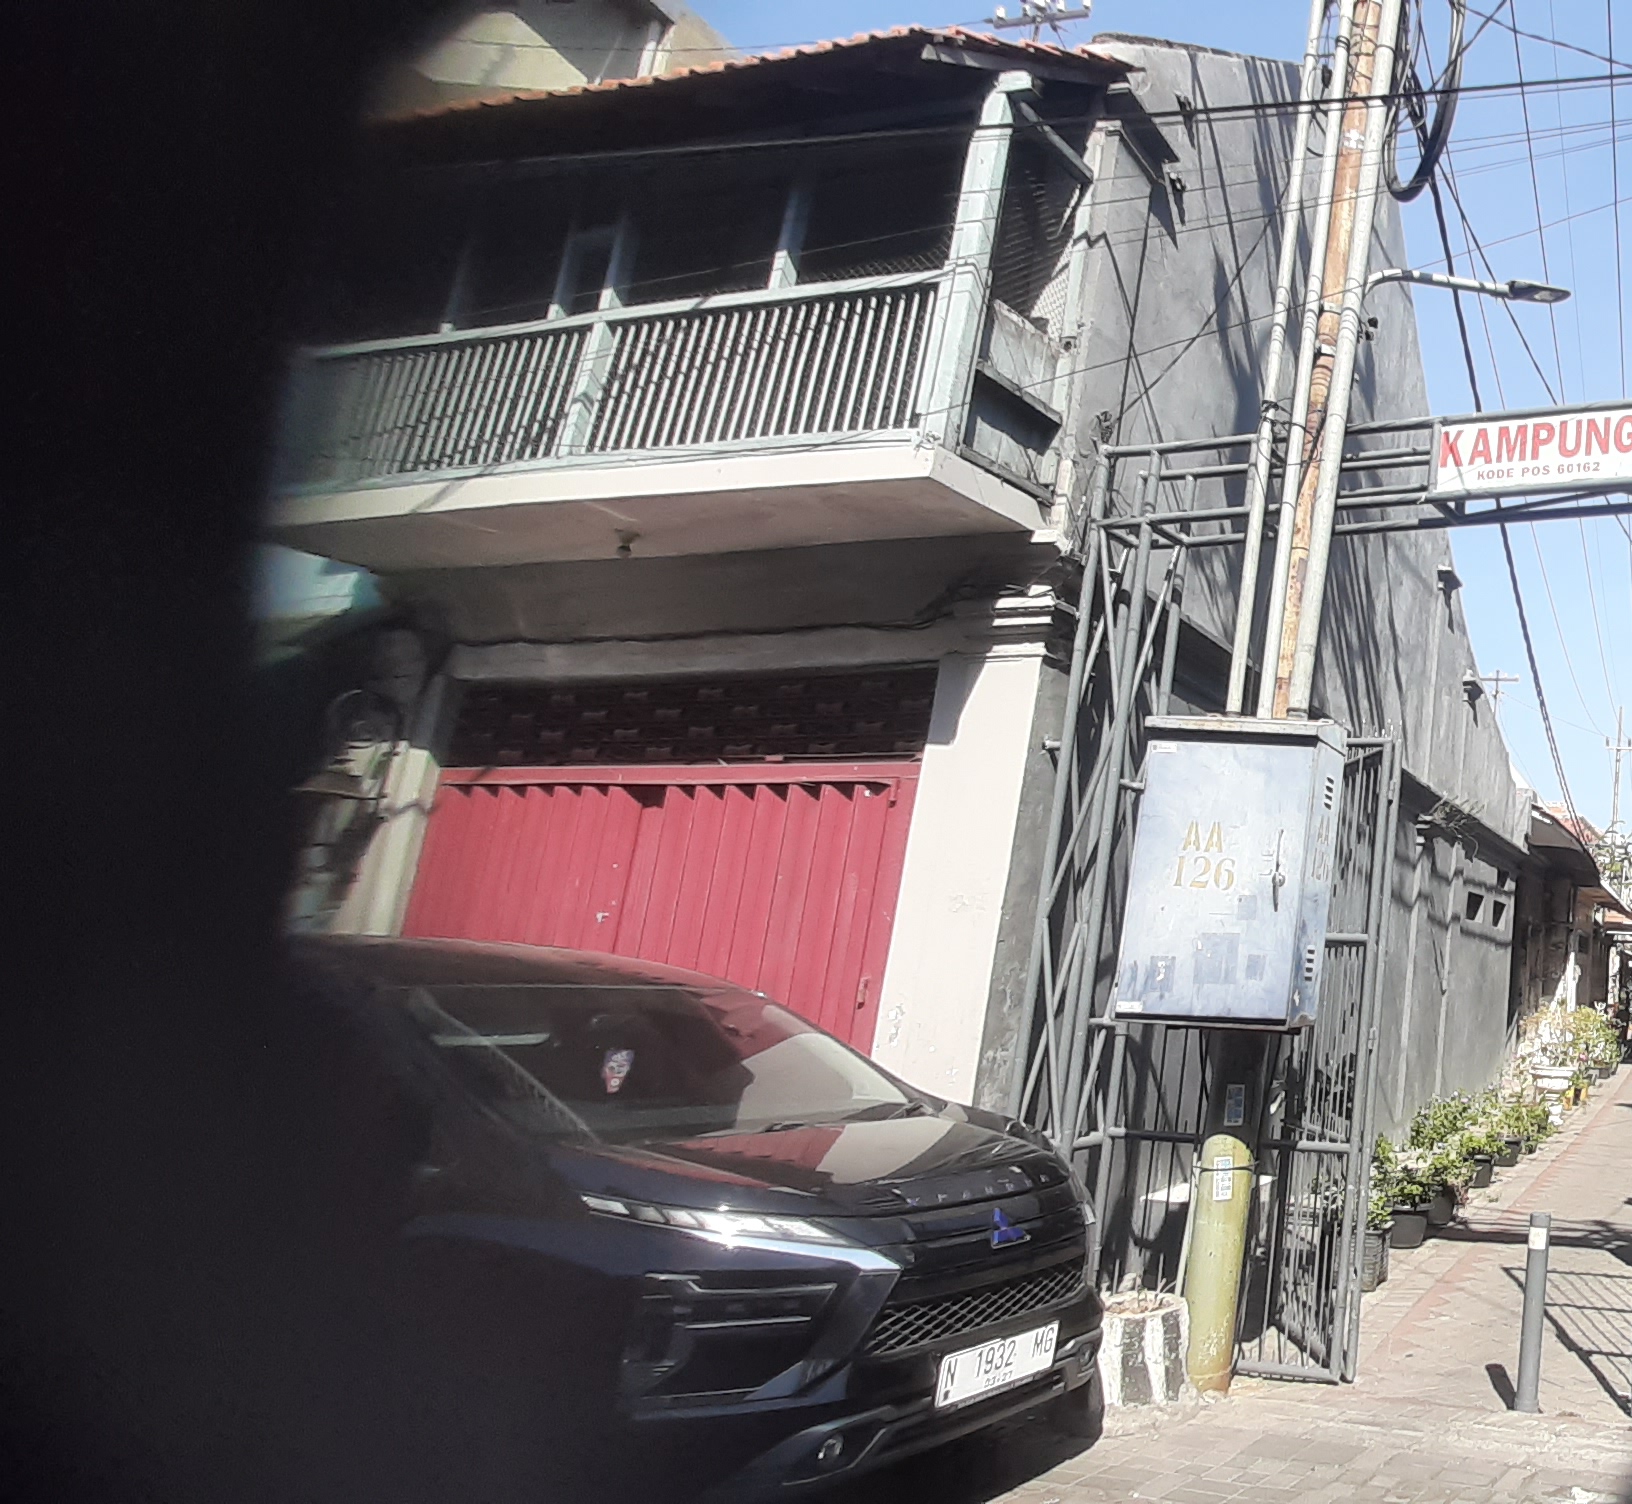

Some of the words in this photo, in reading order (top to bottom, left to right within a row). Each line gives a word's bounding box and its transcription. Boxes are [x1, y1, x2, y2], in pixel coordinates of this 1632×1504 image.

[1477, 468, 1514, 480] KODE
[1521, 465, 1550, 477] POS
[1182, 820, 1223, 853] AA
[1173, 855, 1236, 891] 126
[945, 1358, 958, 1389] N
[976, 1340, 1016, 1378] 1932
[1032, 1326, 1055, 1358] MG
